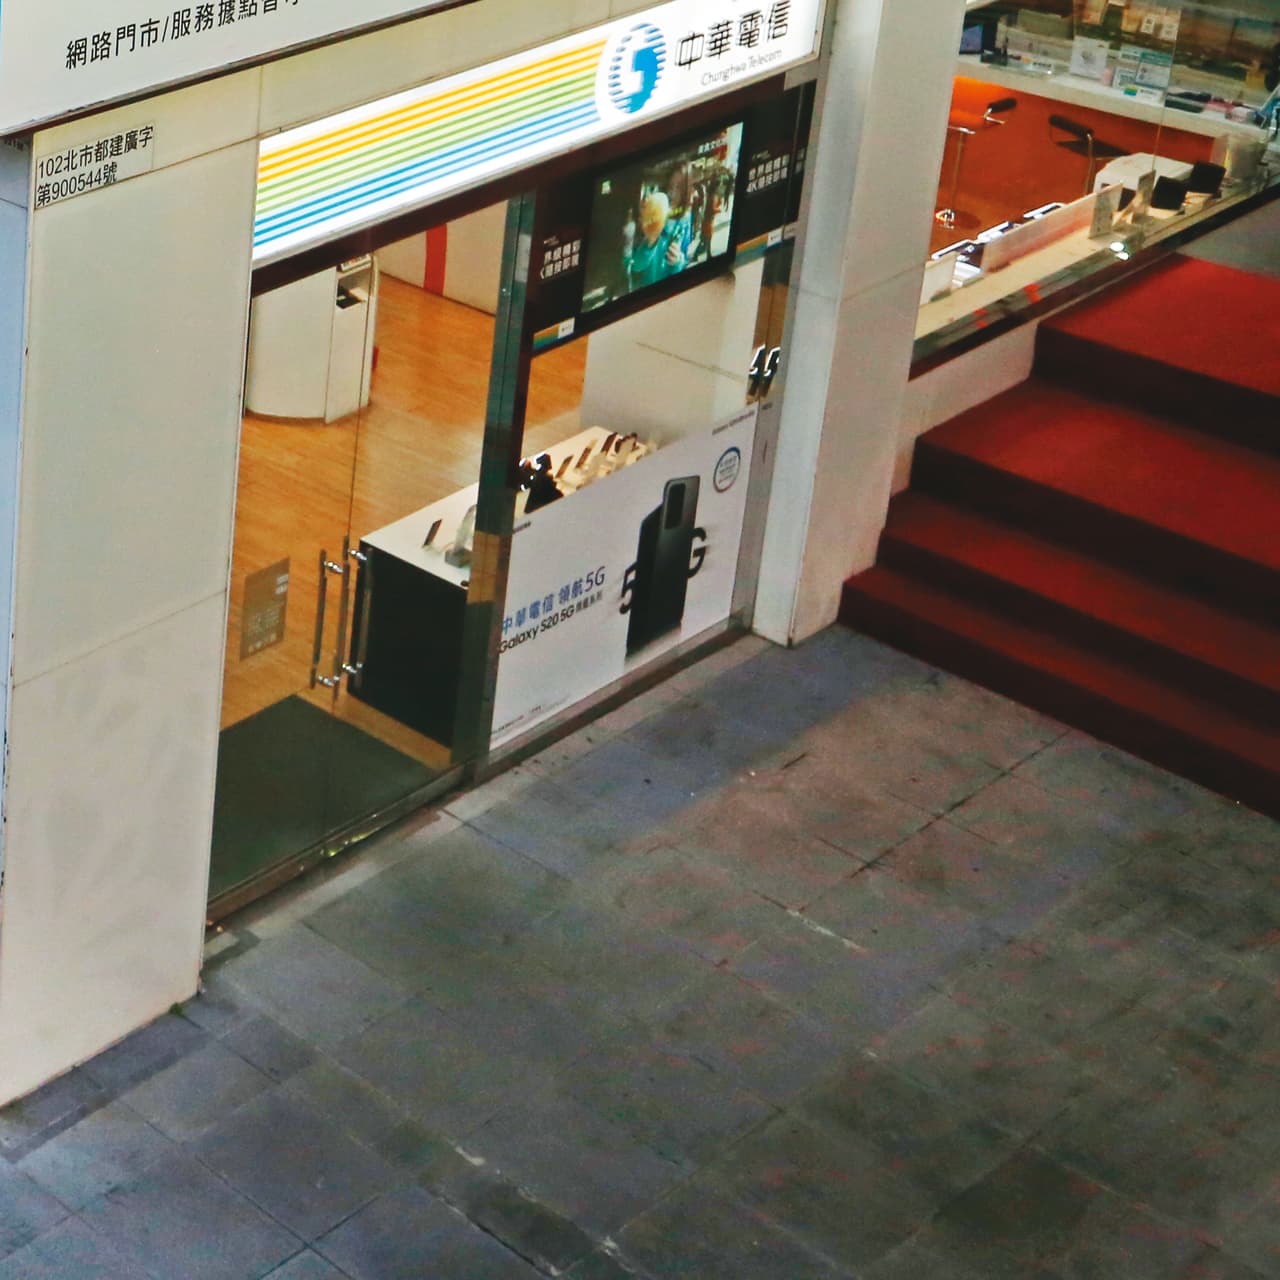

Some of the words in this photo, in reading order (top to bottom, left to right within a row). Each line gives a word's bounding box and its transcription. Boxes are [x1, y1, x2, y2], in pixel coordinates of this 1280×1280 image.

[675, 0, 791, 70] 中華電信
[38, 126, 154, 179] 102北市都建廣字
[36, 161, 118, 209] 第900544號
[499, 624, 539, 654] Galaxy
[540, 613, 559, 633] S20
[560, 604, 575, 622] 5G
[503, 593, 555, 635] 中華電信
